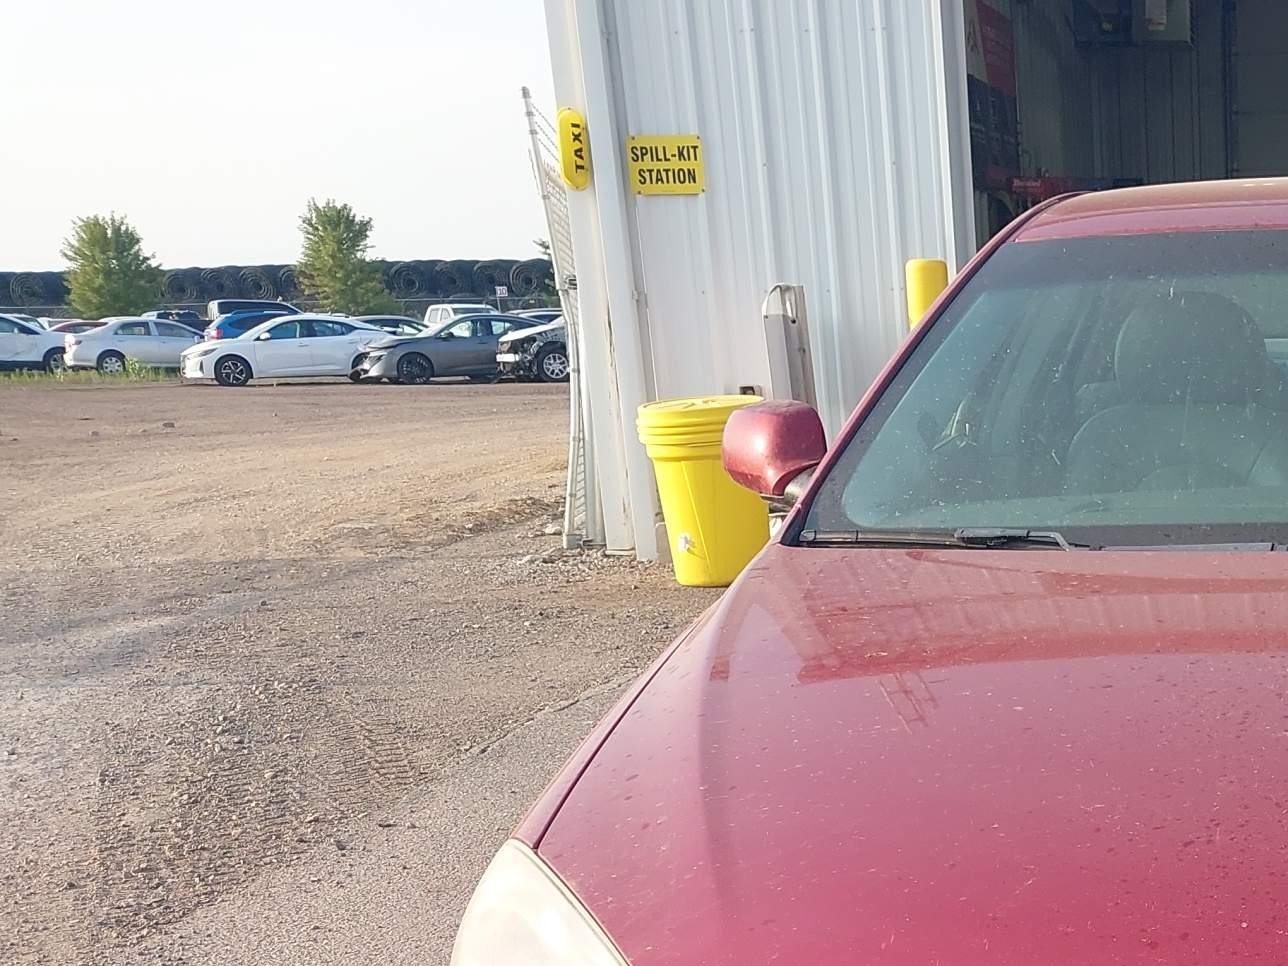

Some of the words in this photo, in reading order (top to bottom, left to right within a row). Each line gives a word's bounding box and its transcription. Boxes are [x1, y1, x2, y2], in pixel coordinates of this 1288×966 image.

[571, 123, 585, 174] TAXI
[630, 145, 699, 162] SPILL-KIT
[637, 168, 697, 185] STATION
